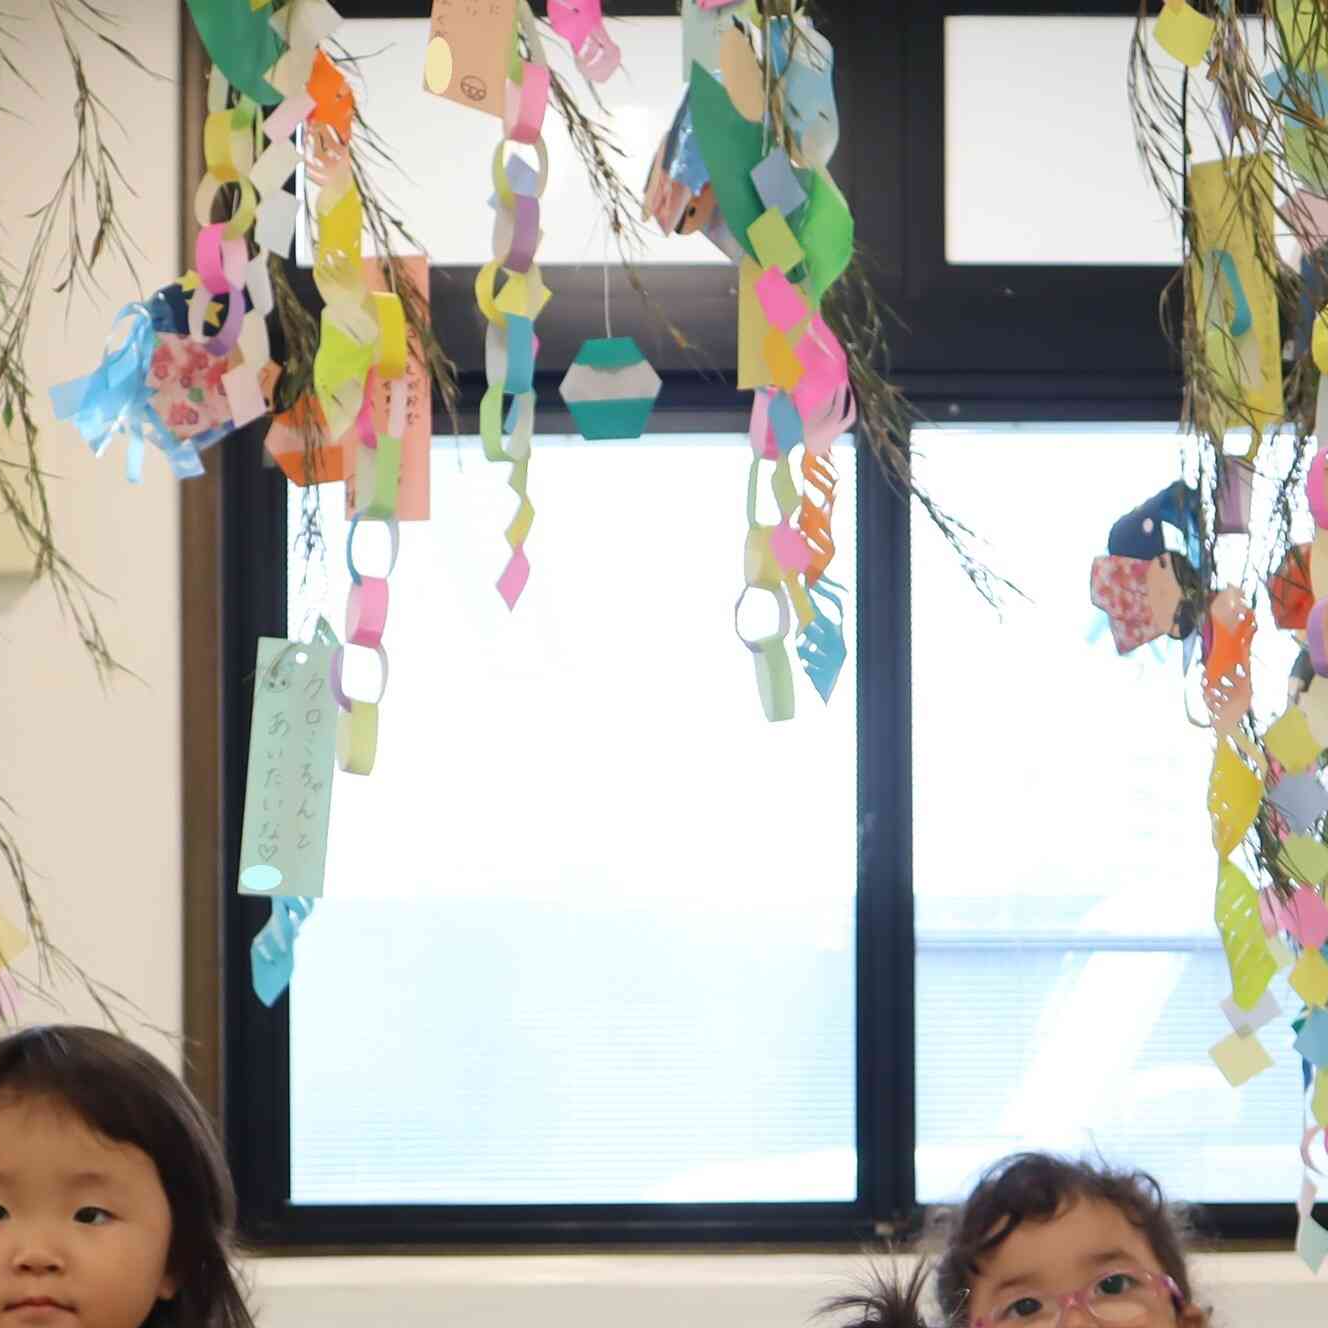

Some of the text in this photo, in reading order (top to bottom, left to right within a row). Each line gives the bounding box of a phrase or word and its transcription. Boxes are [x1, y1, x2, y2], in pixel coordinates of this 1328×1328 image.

[297, 675, 325, 850] クロミちゃんと
